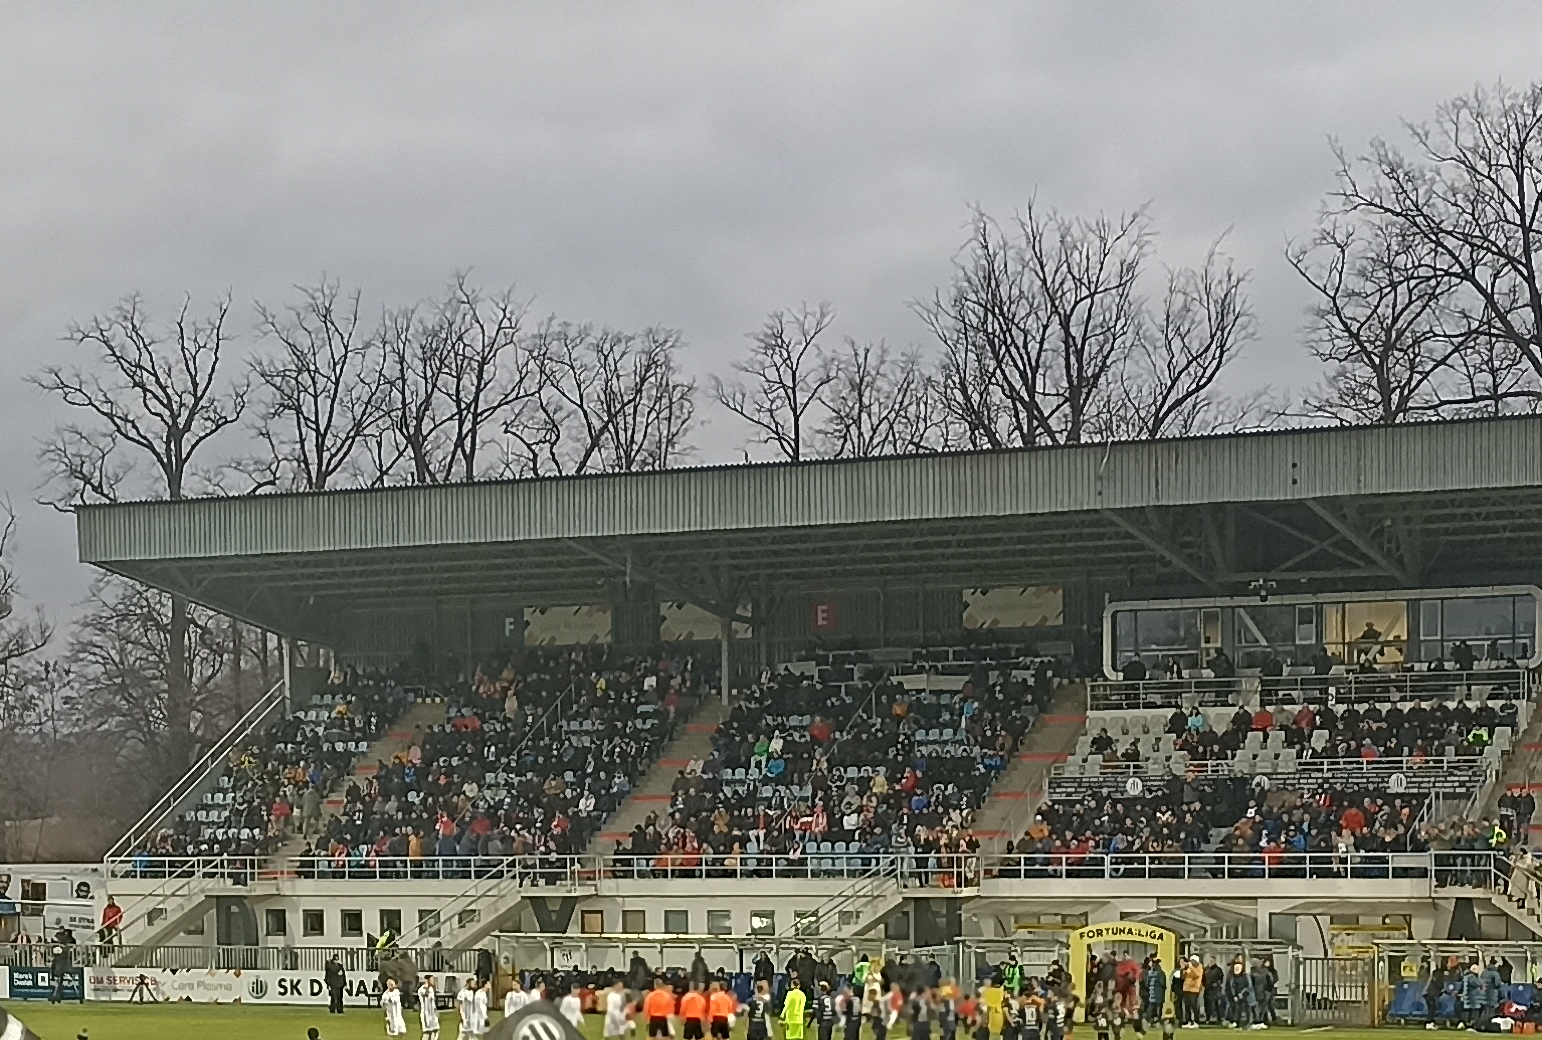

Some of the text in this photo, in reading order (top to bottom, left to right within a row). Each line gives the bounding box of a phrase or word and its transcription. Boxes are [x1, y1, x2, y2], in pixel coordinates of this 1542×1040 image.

[816, 605, 829, 625] E
[504, 617, 515, 637] F
[277, 978, 303, 997] SK
